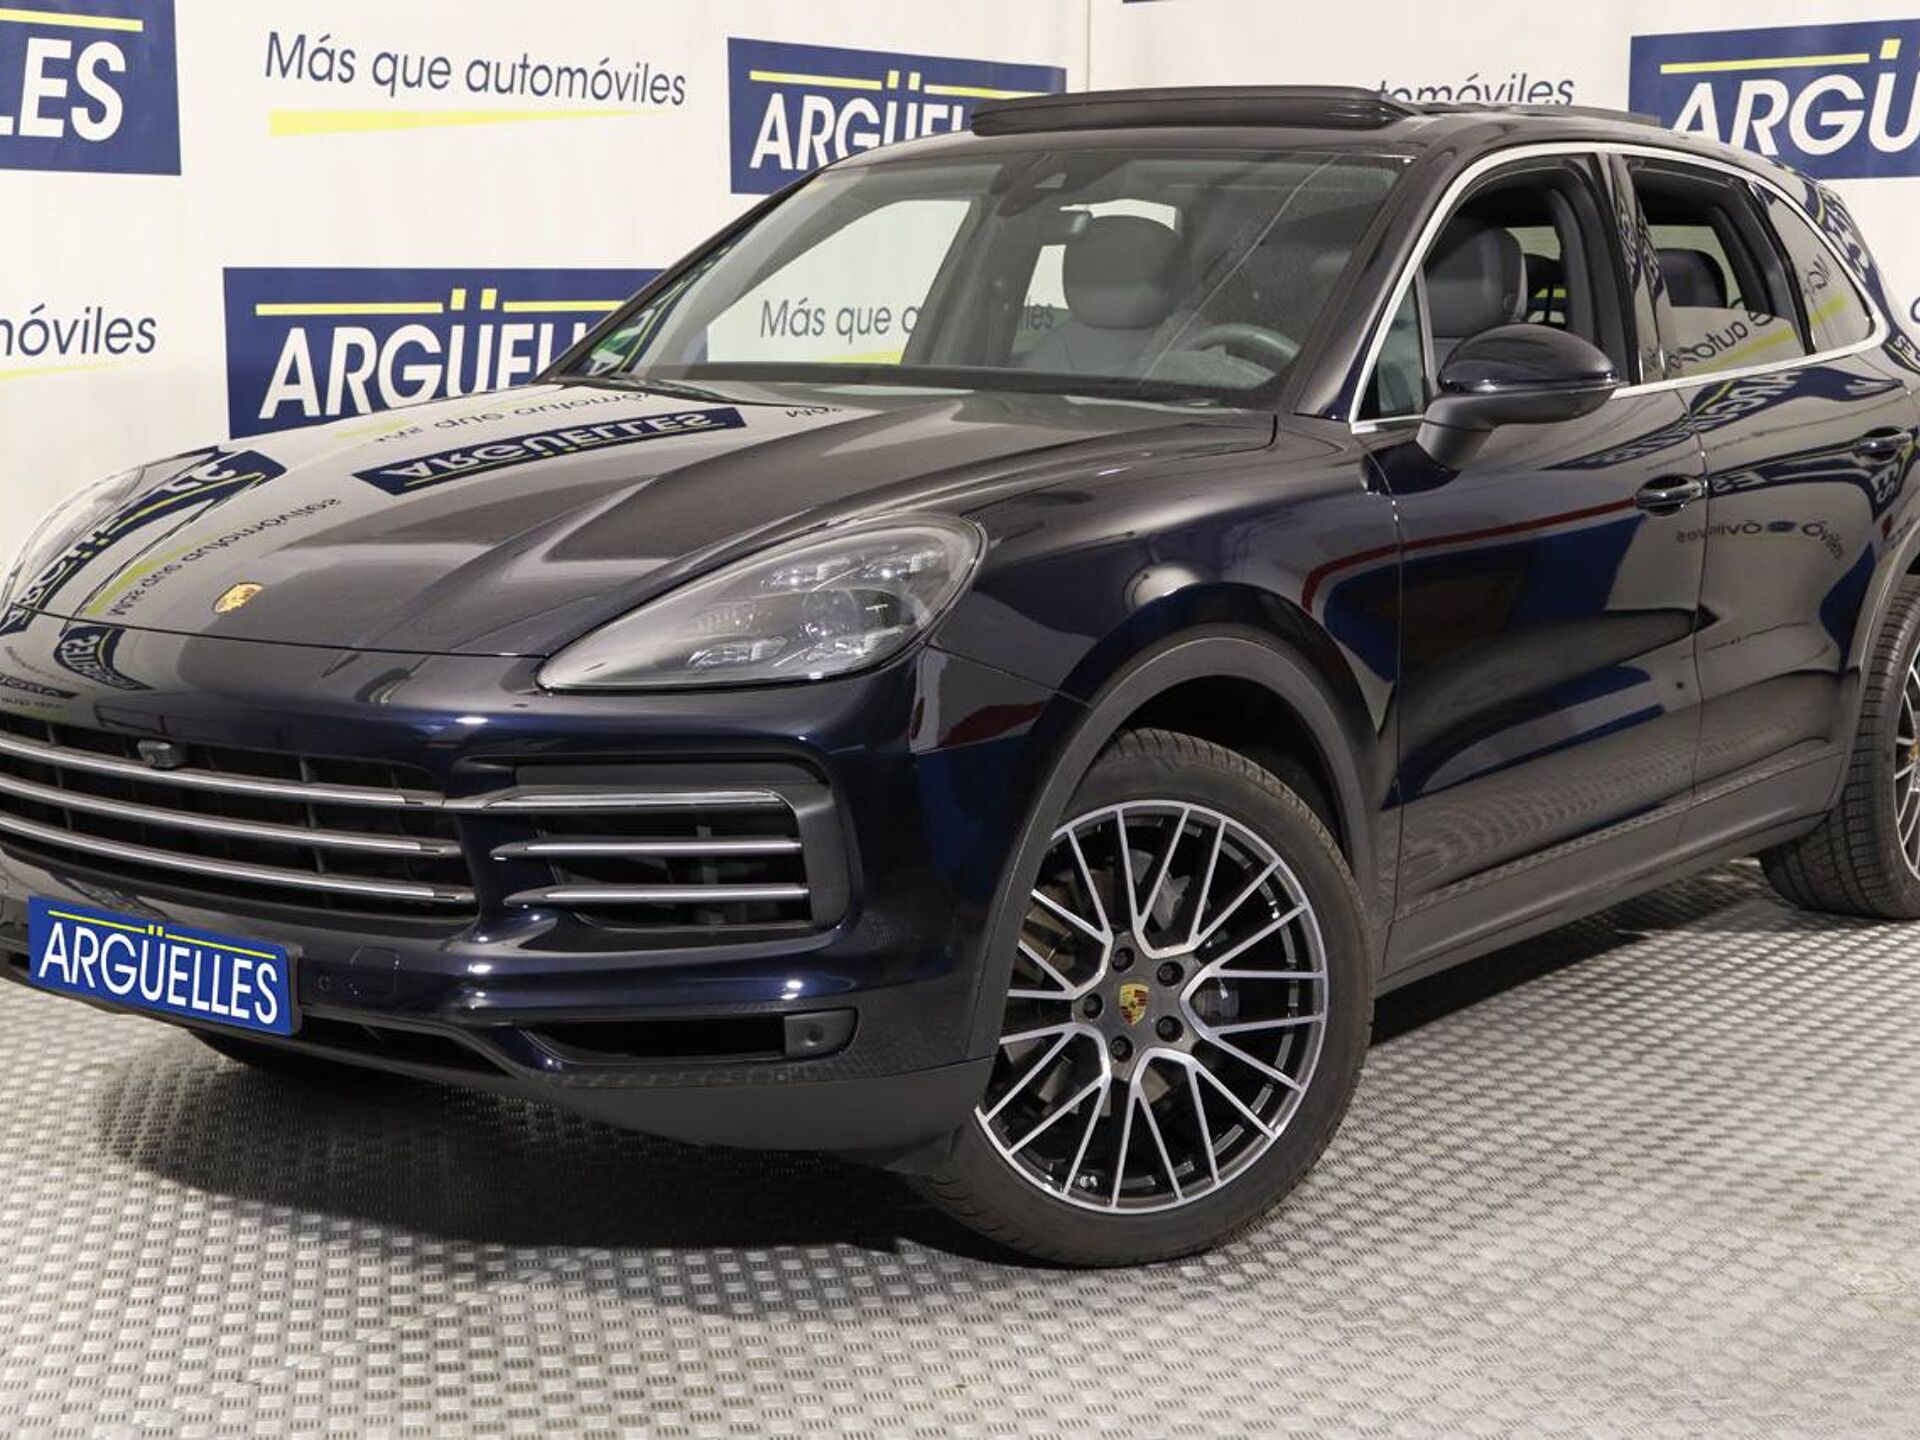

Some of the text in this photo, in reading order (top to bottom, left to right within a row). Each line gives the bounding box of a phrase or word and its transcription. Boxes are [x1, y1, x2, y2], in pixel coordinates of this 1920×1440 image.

[265, 31, 686, 106] Más que automóviles
[760, 297, 825, 338] Más
[836, 306, 892, 344] que
[38, 921, 278, 1025] ARGÜELLES
